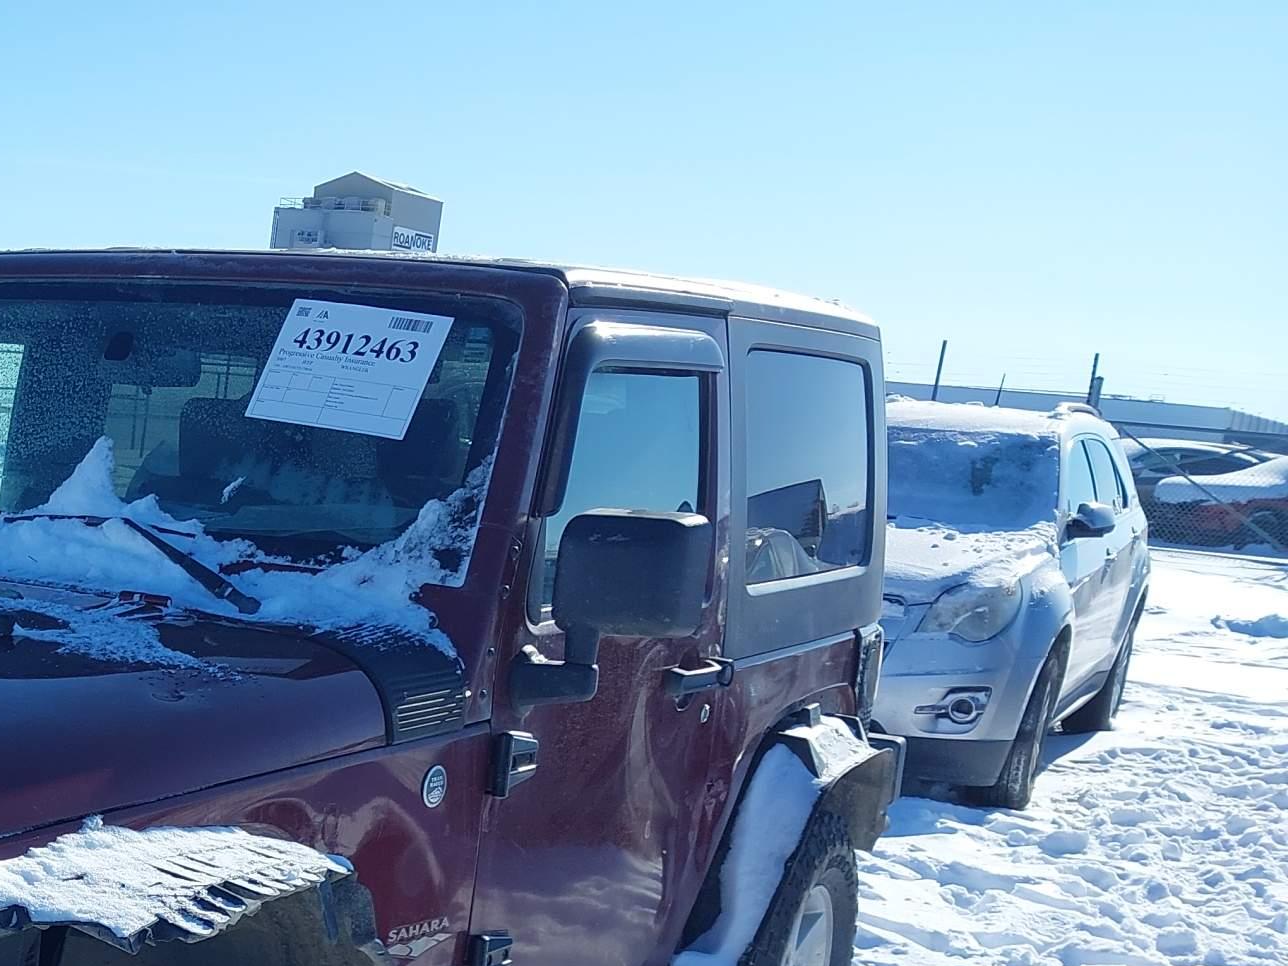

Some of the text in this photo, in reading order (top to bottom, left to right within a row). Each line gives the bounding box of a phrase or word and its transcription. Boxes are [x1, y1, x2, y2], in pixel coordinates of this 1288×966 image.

[393, 231, 432, 251] ROANOKE
[293, 327, 420, 363] 43912463
[278, 347, 315, 359] Progressive
[315, 352, 343, 364] Casualty
[345, 356, 376, 367] Insurance
[387, 916, 450, 942] SAHARA
